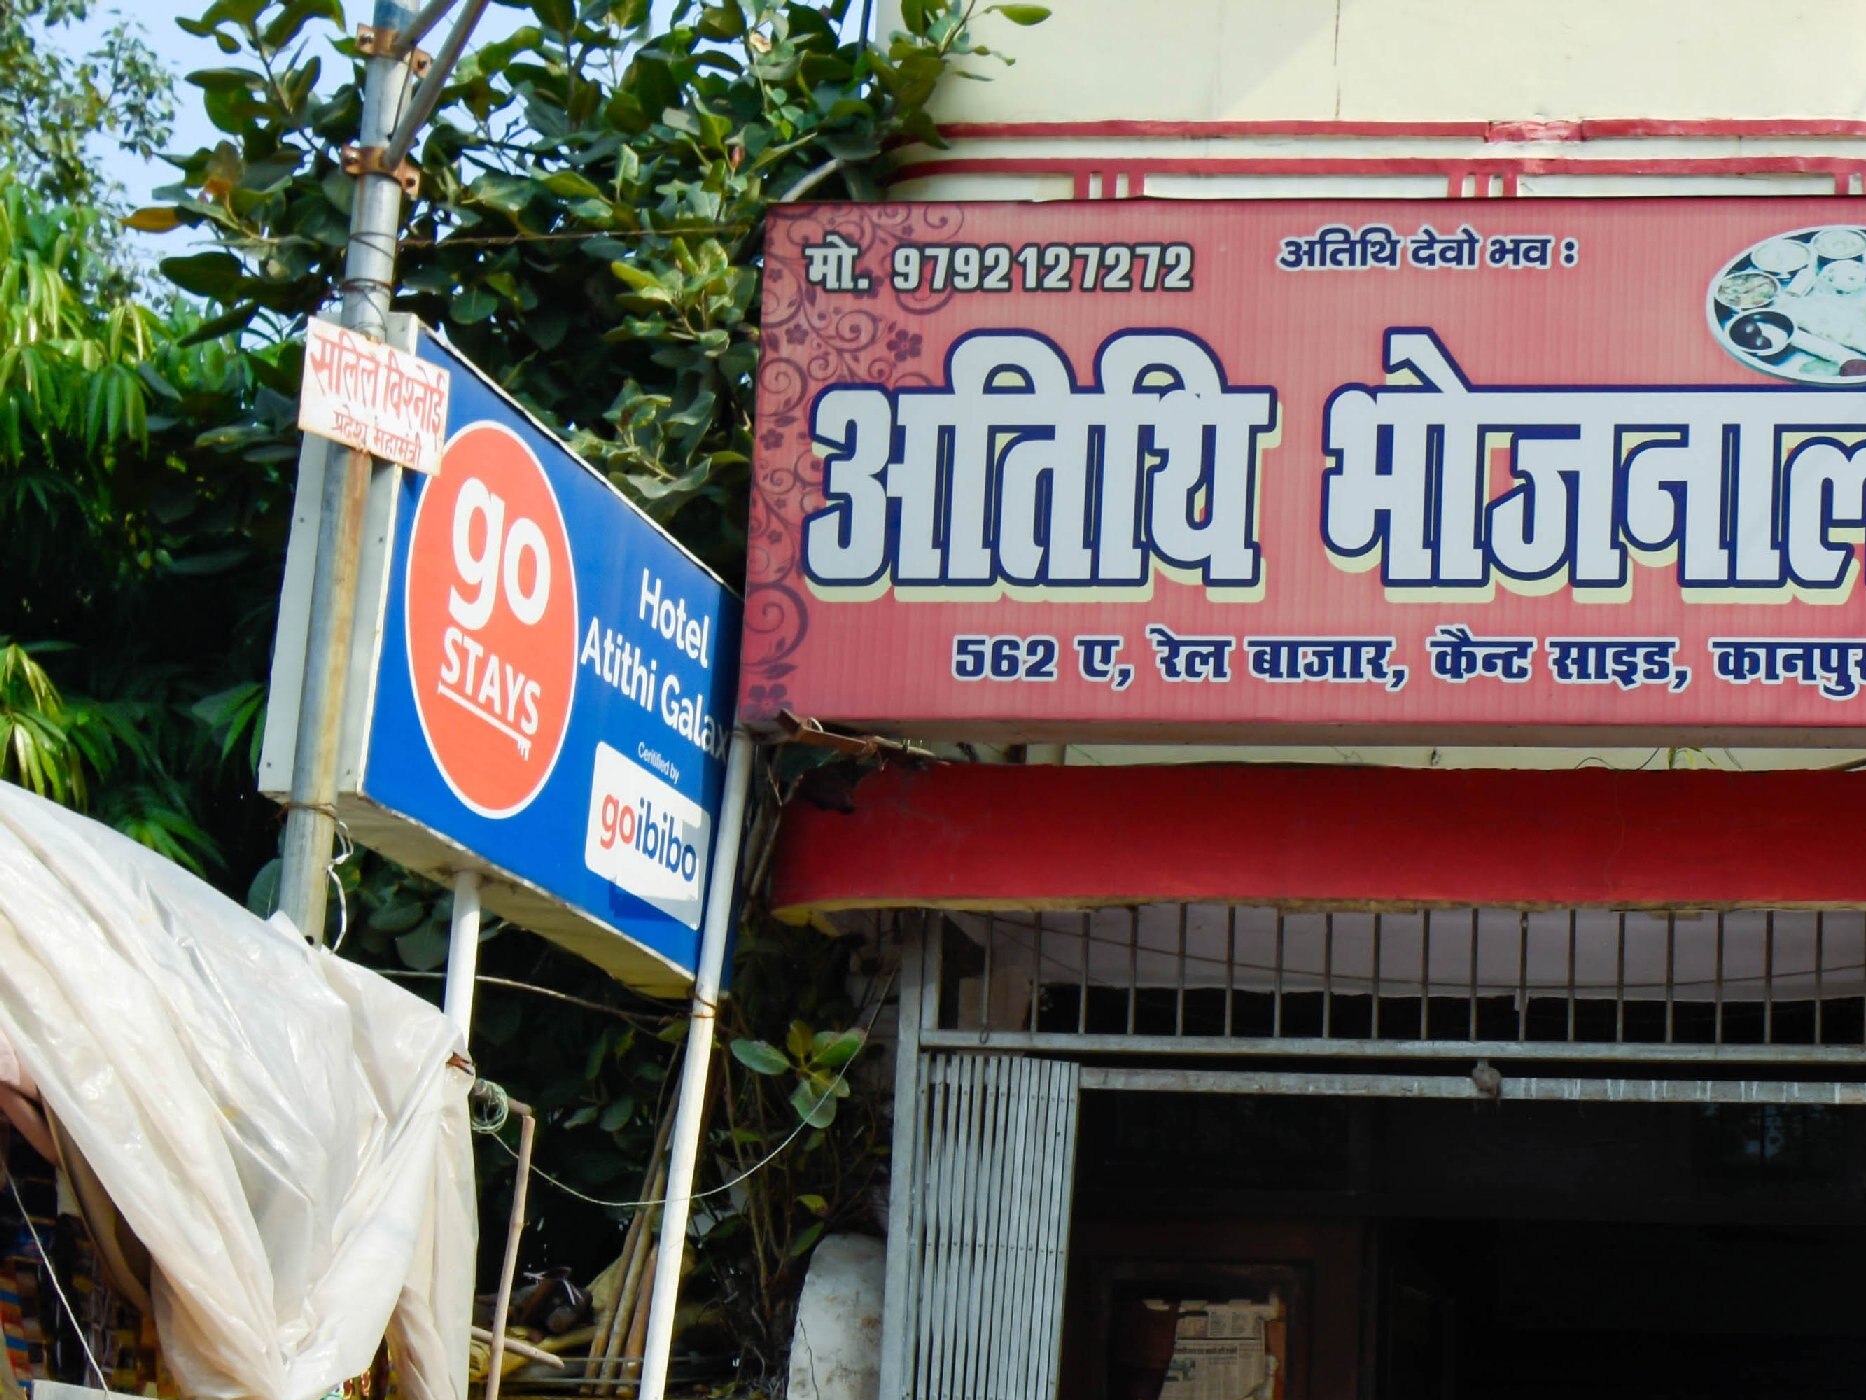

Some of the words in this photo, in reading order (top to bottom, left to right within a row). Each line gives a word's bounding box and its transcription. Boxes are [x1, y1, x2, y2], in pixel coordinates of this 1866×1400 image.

[804, 233, 871, 292] मो.
[892, 241, 1194, 293] 9792127272
[1279, 225, 1401, 268] अतिथि
[1410, 226, 1481, 267] देवो
[801, 327, 1280, 592] अतिथि
[449, 477, 551, 631] go
[580, 616, 657, 712] Atithi
[639, 567, 709, 669] Hotel
[954, 636, 1056, 680] 562
[1075, 637, 1134, 688] ए,
[1146, 626, 1233, 680] रेल
[1246, 637, 1408, 690] बाजार,
[1427, 627, 1537, 680] कैन्ट
[1546, 638, 1690, 690] साइड,
[440, 626, 541, 735] STAYS
[670, 762, 680, 785] by
[600, 793, 697, 882] goibibo
